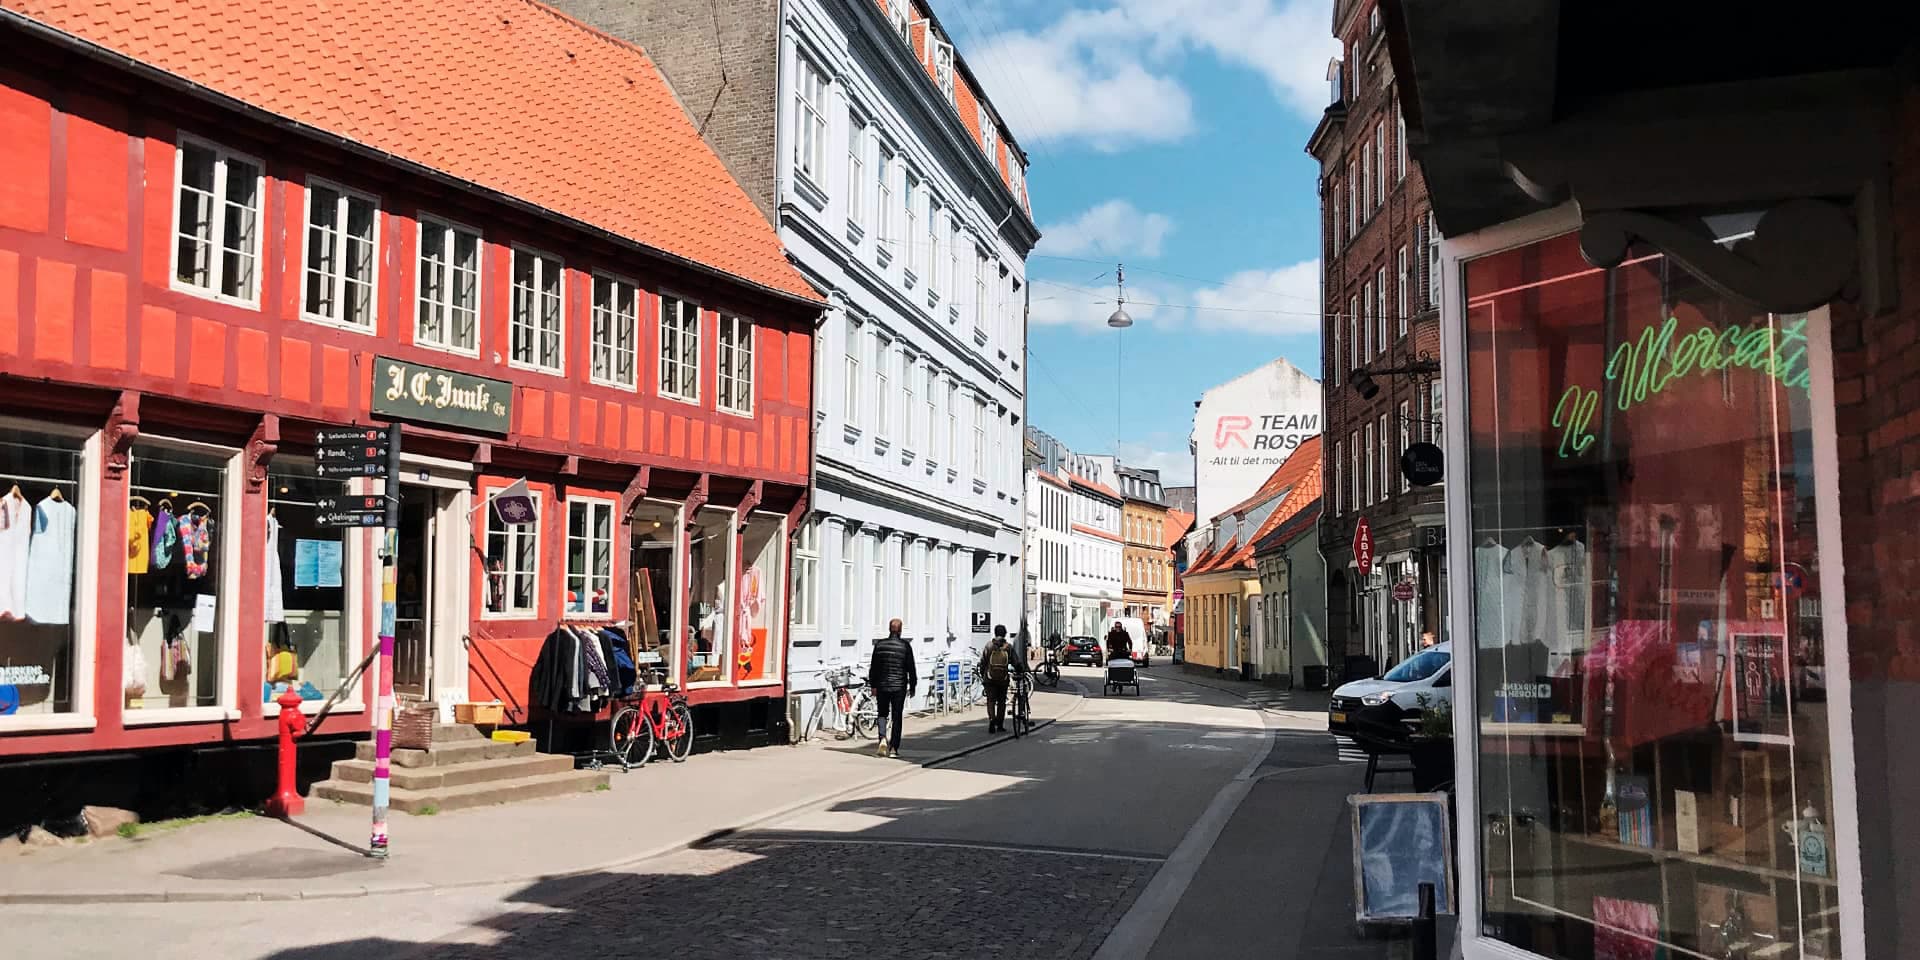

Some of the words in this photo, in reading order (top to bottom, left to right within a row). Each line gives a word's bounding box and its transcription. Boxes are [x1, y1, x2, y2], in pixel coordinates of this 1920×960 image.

[1259, 414, 1318, 430] TEAM
[1253, 434, 1313, 450] RØS
[1230, 456, 1240, 465] til
[1242, 456, 1259, 465] det
[328, 499, 336, 508] Ry
[1360, 525, 1370, 568] TABAC
[976, 613, 986, 626] P
[5, 665, 43, 675] KIRKENS
